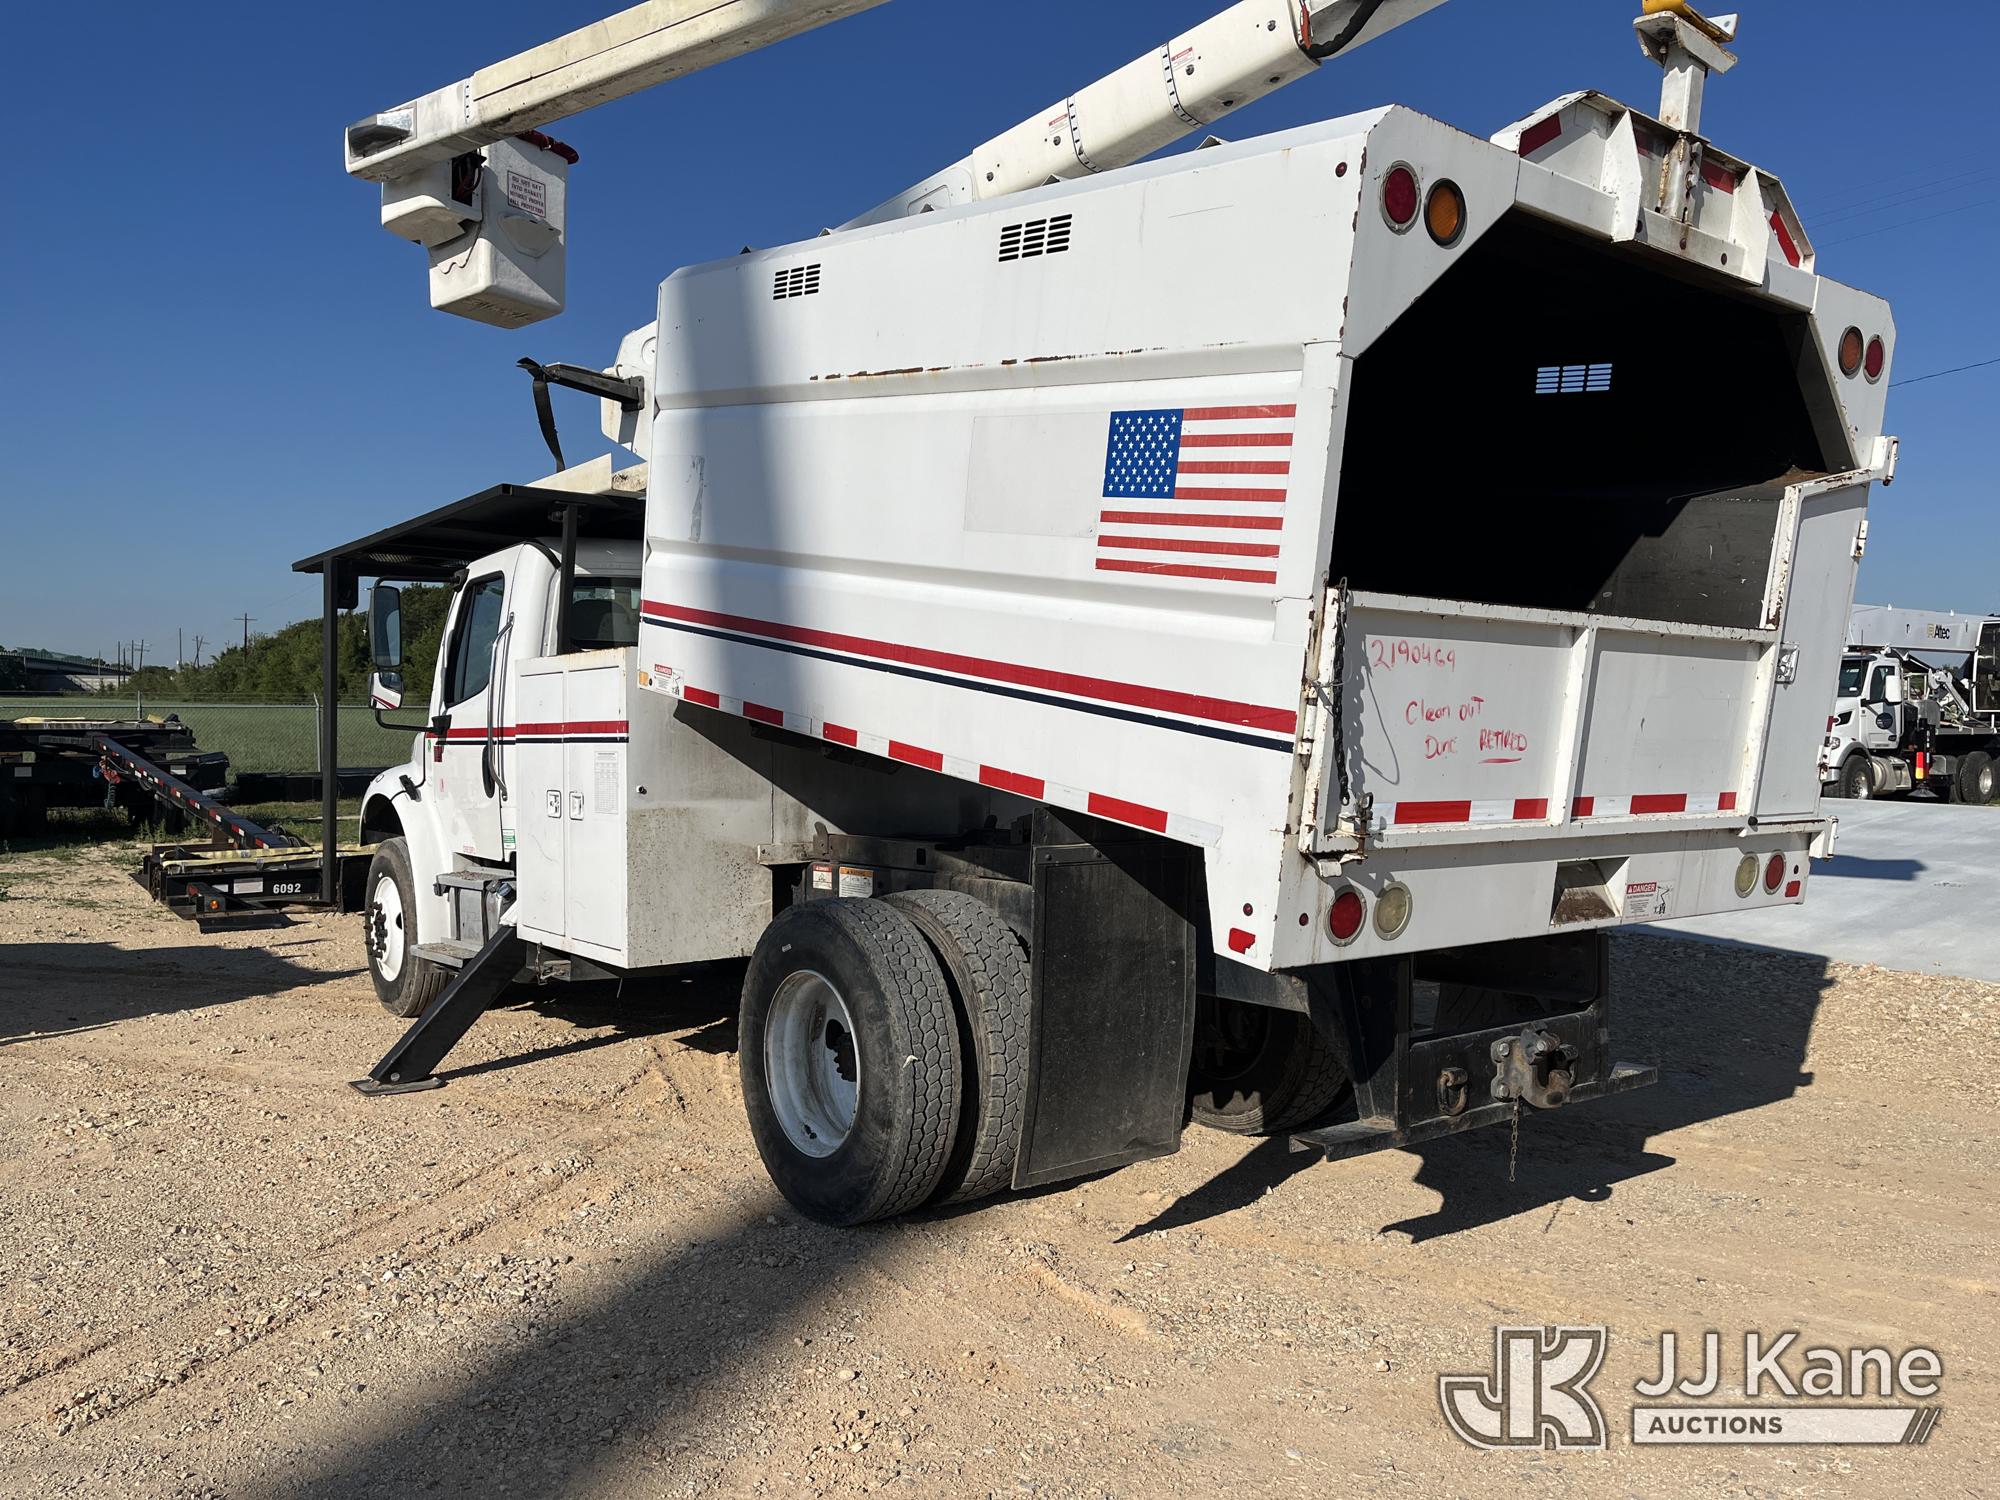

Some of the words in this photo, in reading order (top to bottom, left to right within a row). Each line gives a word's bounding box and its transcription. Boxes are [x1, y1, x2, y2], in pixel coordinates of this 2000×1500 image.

[511, 183, 523, 191] INTO
[1934, 624, 1950, 640] Altec
[1371, 639, 1456, 672] 2190469
[1405, 699, 1450, 725] Clean
[1479, 728, 1528, 752] RETIRED
[273, 883, 301, 894] 6092
[1633, 883, 1656, 893] DANGER
